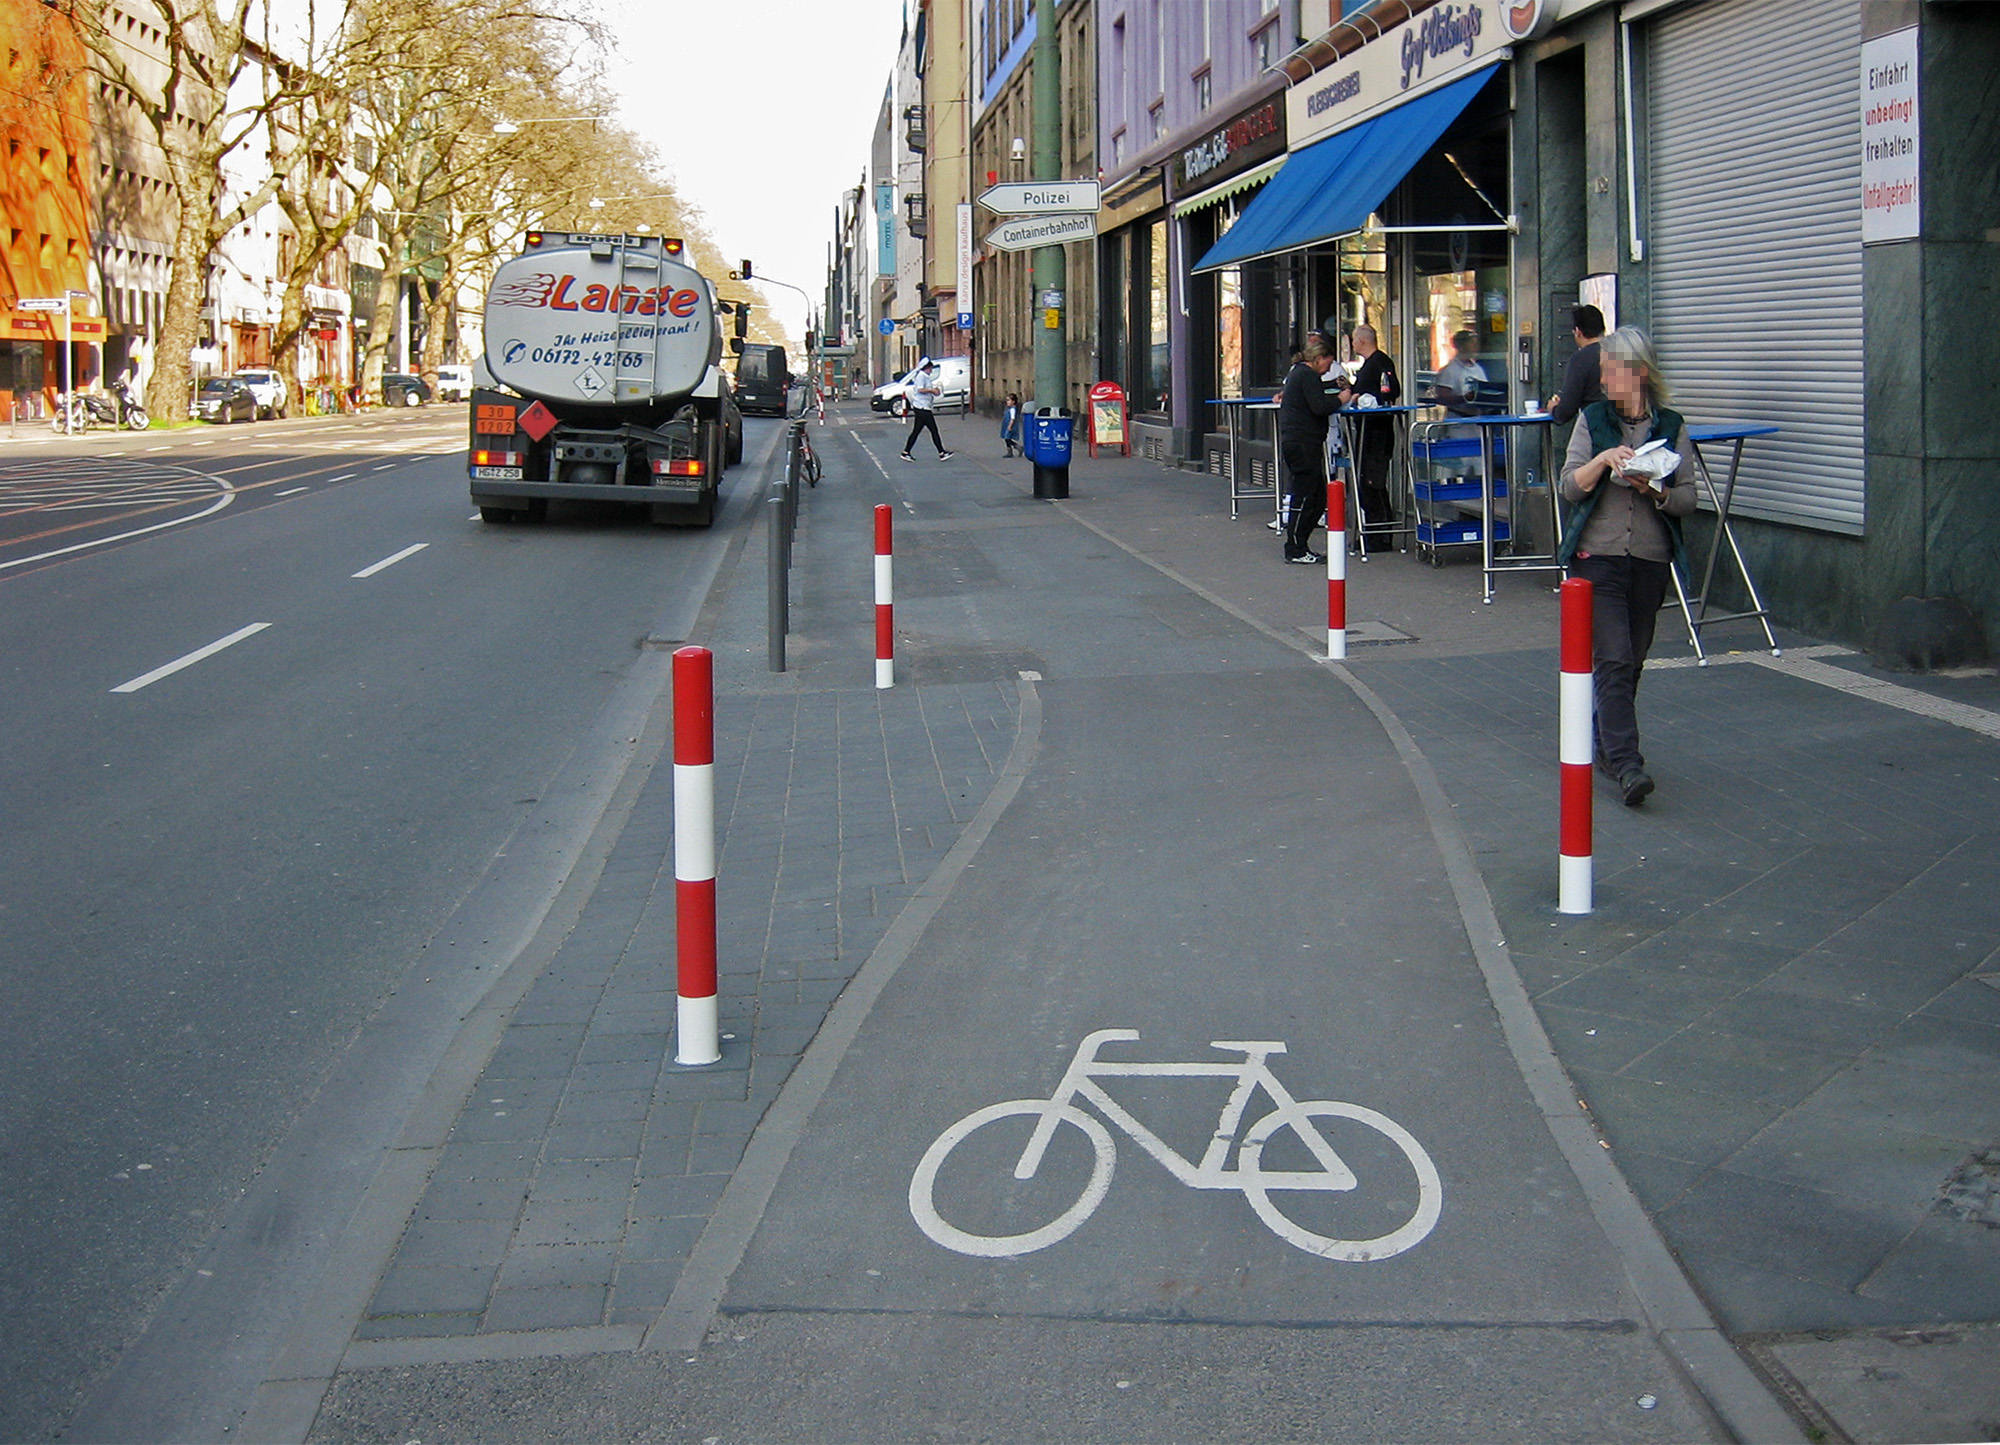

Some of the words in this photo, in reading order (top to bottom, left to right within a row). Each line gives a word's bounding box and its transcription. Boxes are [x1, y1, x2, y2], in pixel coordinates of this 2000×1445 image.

[1869, 61, 1908, 90] Einfahrt
[1307, 70, 1360, 118] FLEISCHEREI
[1865, 96, 1912, 126] unbedingt
[1866, 135, 1912, 162] freihalten
[1024, 190, 1070, 205] Polizei
[960, 211, 969, 250] kaufhaus
[1004, 216, 1089, 242] Containerbahnhof
[960, 251, 970, 279] design
[550, 275, 700, 318] Lange
[554, 335, 577, 347] Ihr
[488, 407, 503, 418] 30
[480, 421, 512, 433] 1202
